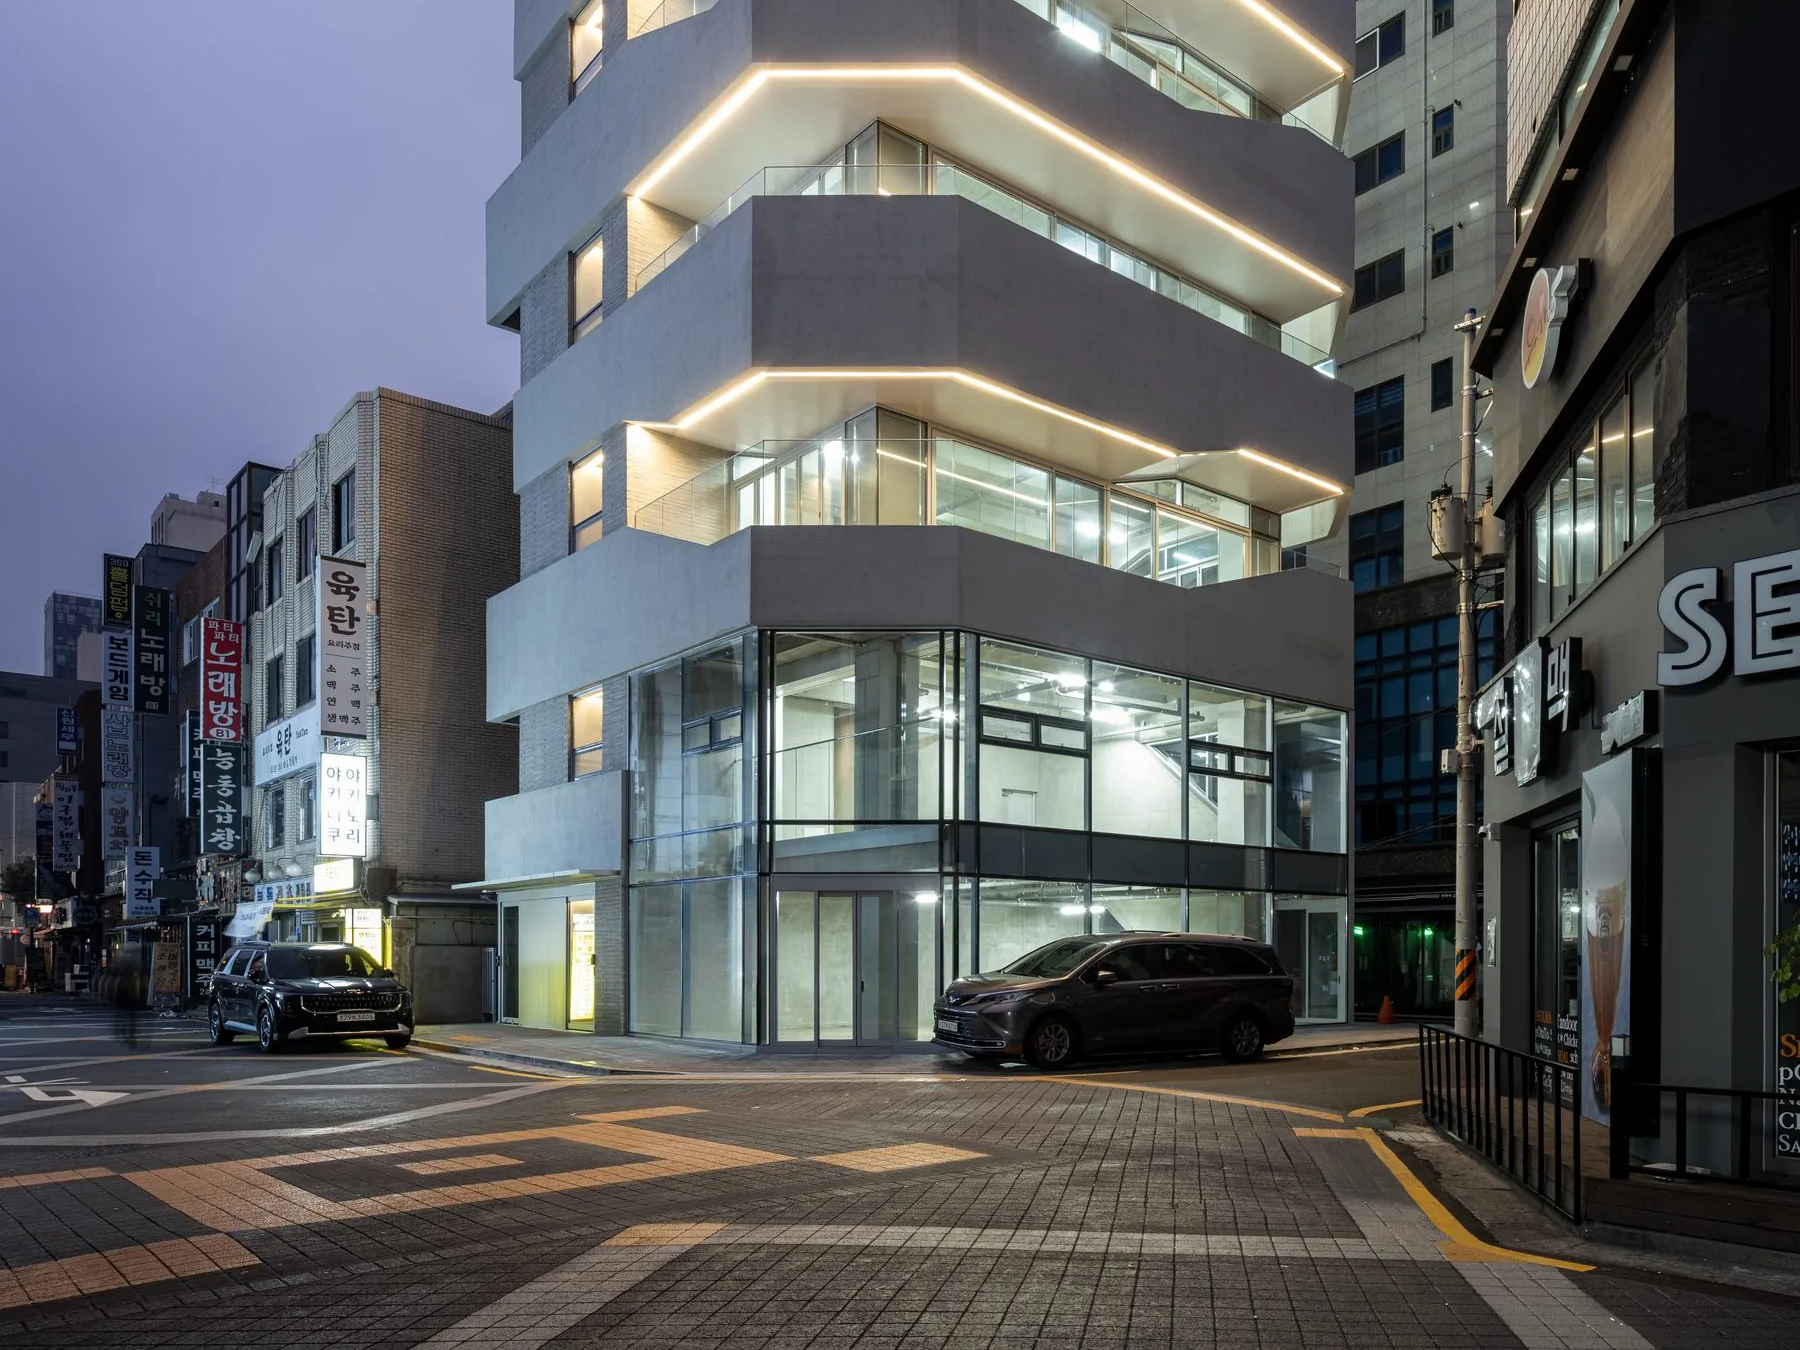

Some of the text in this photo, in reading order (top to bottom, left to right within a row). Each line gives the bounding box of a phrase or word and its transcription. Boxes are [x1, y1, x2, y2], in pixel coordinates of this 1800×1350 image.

[208, 621, 233, 633] 파티
[326, 571, 360, 636] 육탄
[140, 628, 167, 697] 노래방
[213, 631, 239, 644] 파티
[327, 639, 360, 651] 요리주점
[108, 635, 129, 702] 보드게임
[207, 641, 239, 727] 노래방
[216, 728, 230, 738] B1
[276, 723, 292, 758] 육탄
[206, 748, 241, 851] 능동곱창
